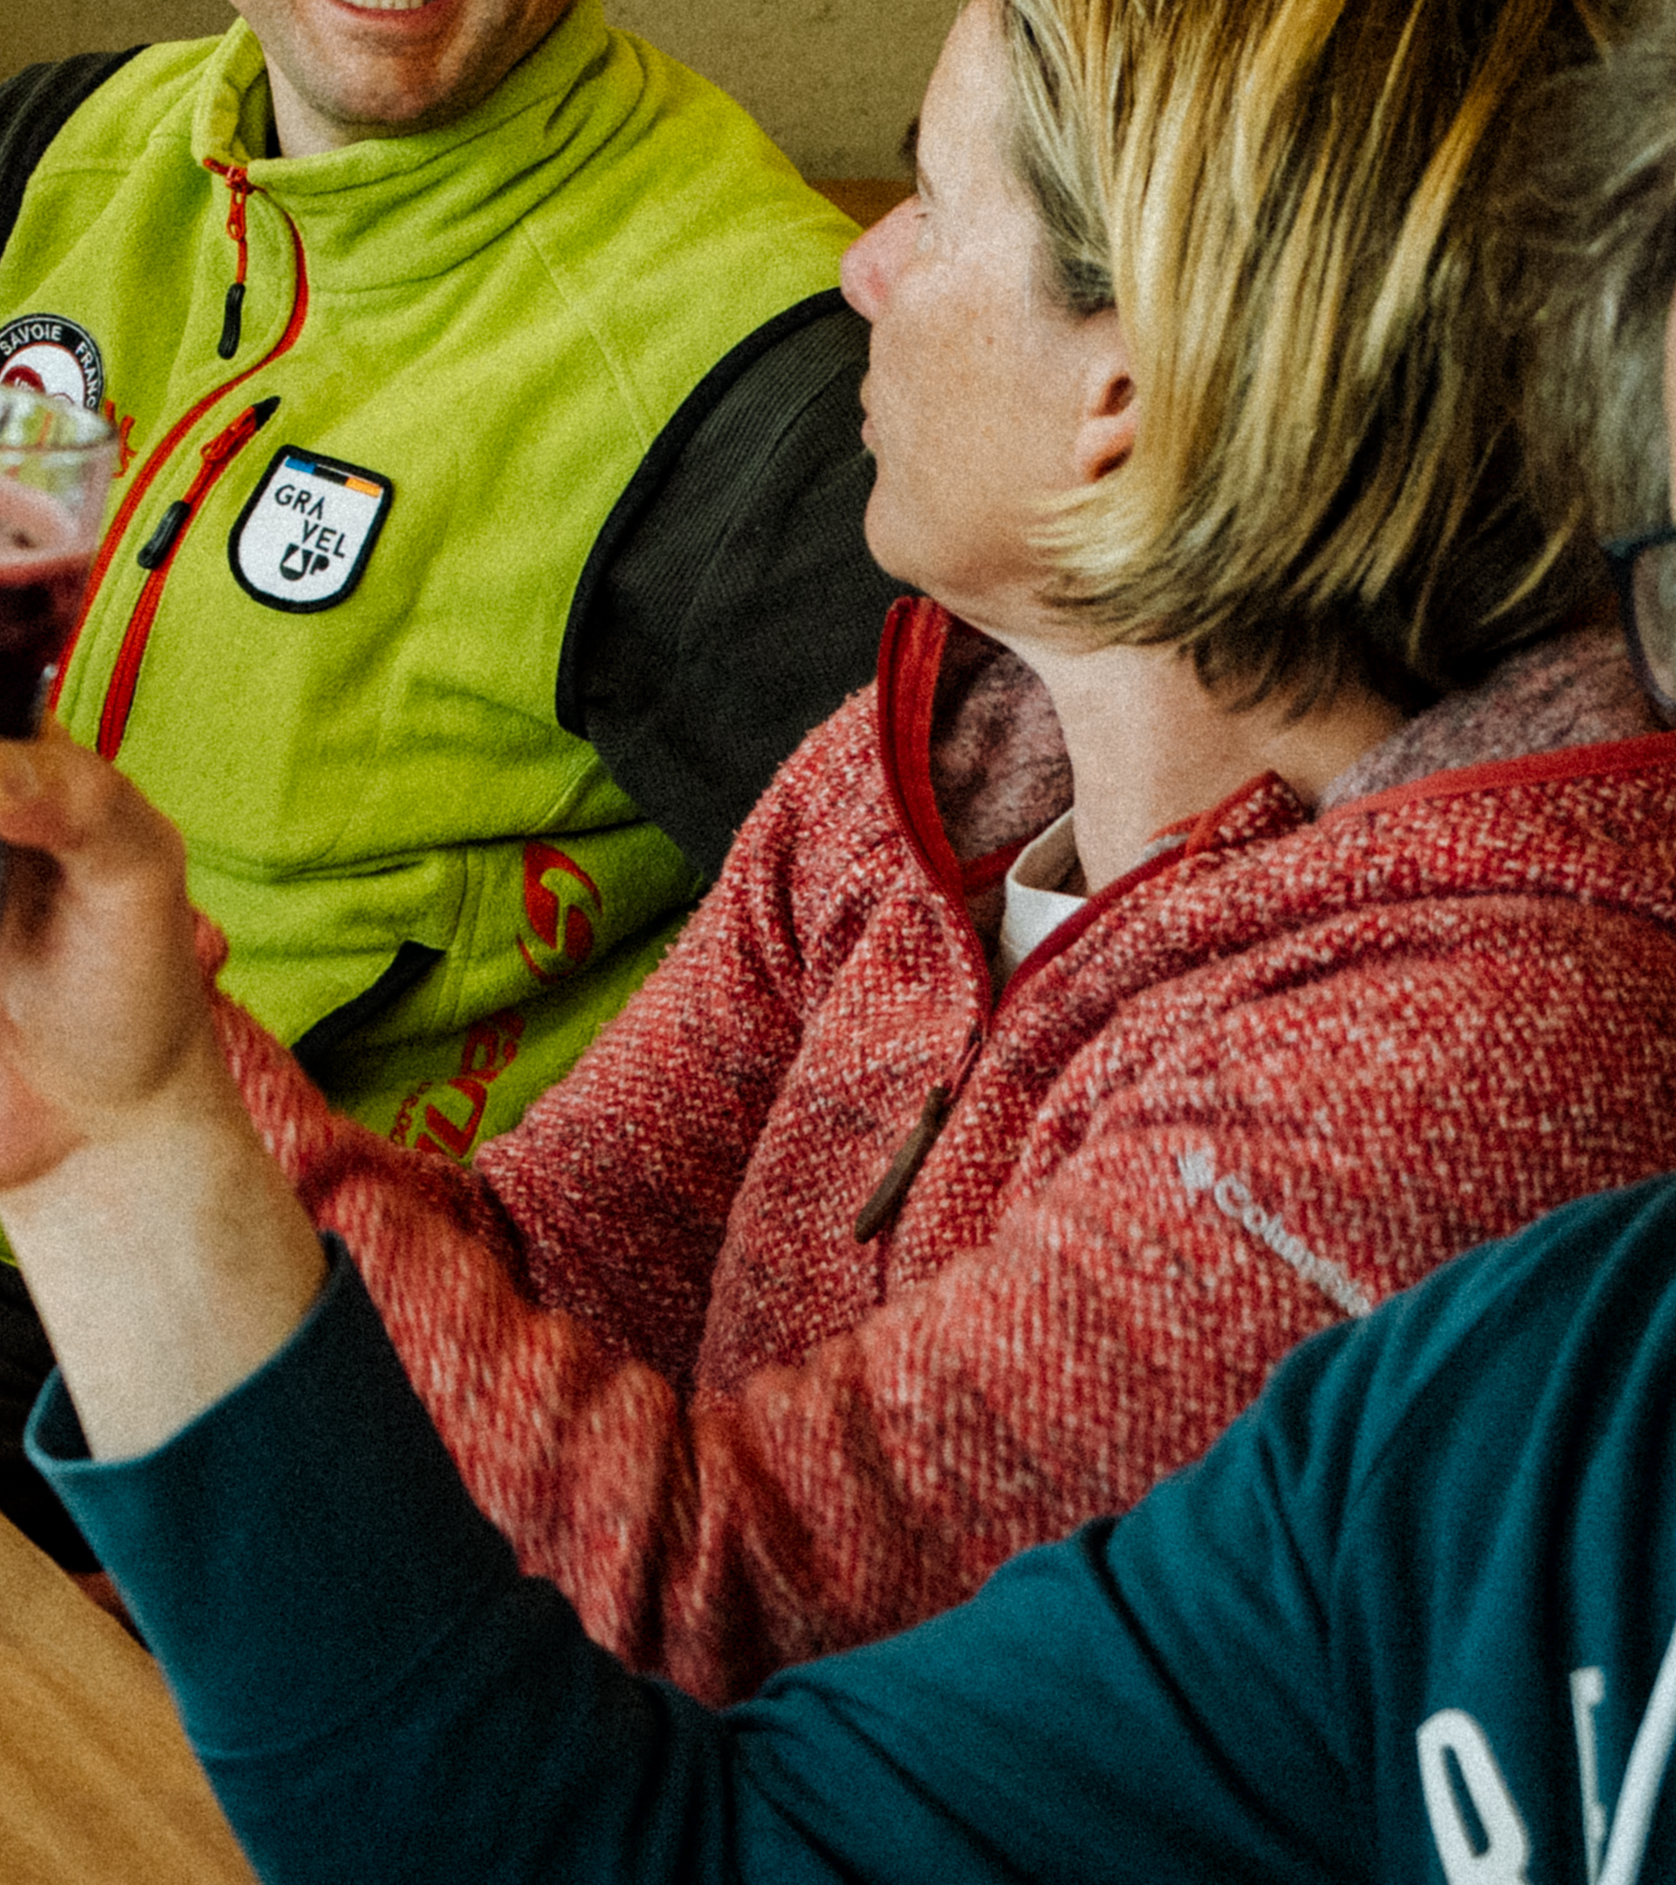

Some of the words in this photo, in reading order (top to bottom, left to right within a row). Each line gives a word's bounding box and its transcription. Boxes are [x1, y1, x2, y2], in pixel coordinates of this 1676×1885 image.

[0, 323, 63, 357] SAVOIE
[75, 341, 100, 409] FRANC
[274, 483, 326, 520] GRA
[302, 519, 346, 559] VEL
[279, 542, 331, 582] UP
